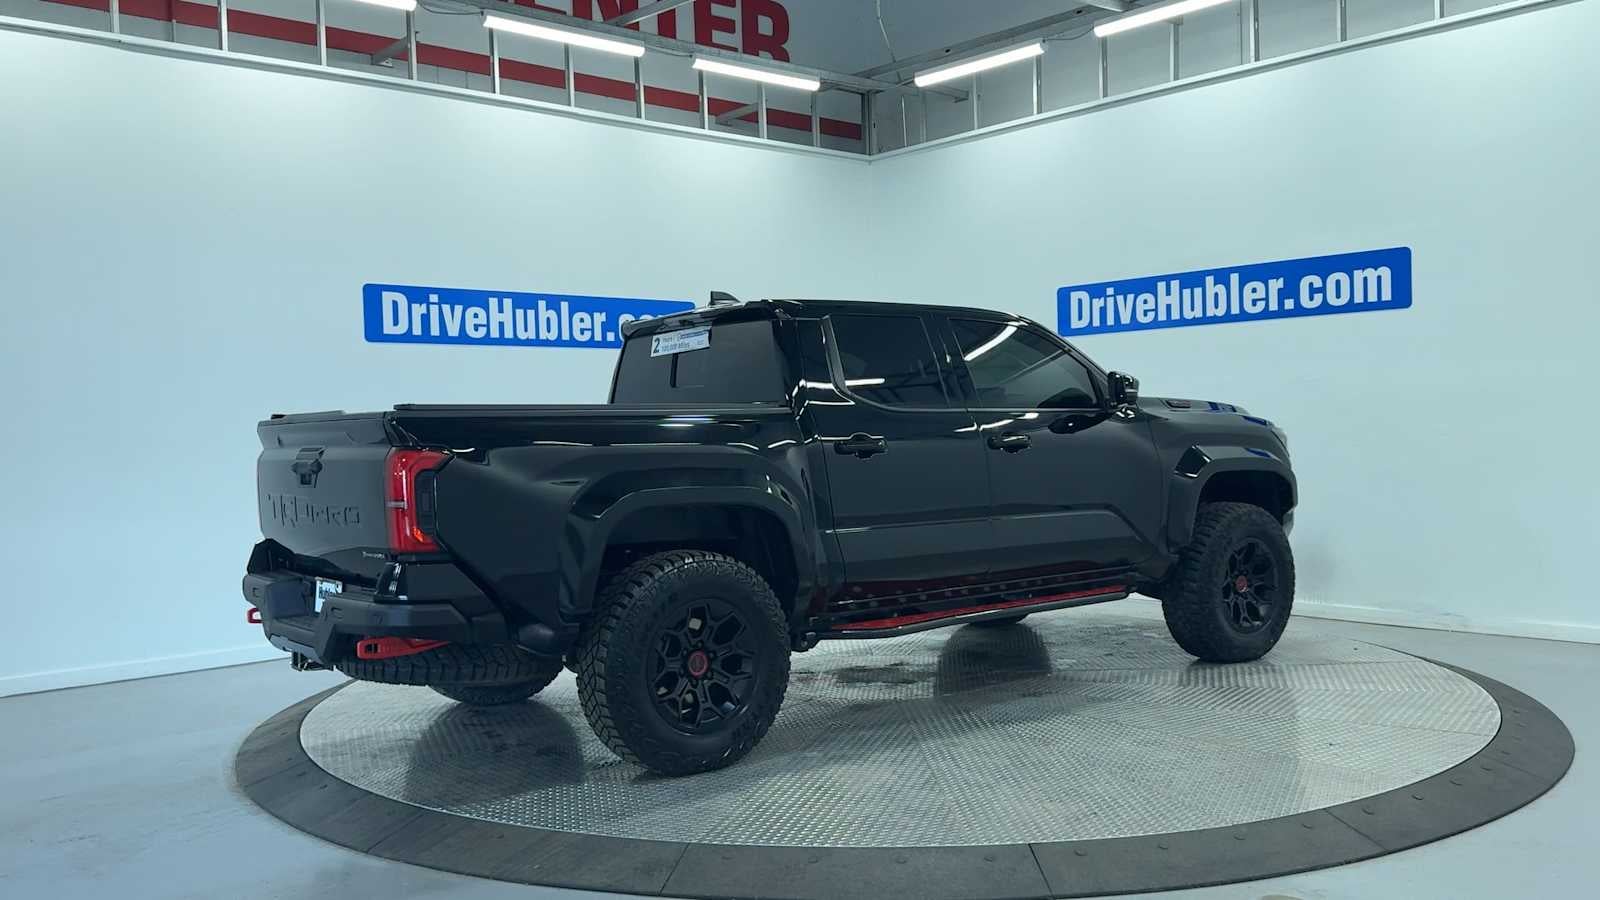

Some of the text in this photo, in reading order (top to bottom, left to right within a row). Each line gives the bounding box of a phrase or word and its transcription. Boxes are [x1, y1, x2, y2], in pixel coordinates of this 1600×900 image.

[381, 290, 664, 343] DriveHubler.c
[1069, 265, 1393, 329] DriveHubler.com
[653, 337, 660, 354] 2
